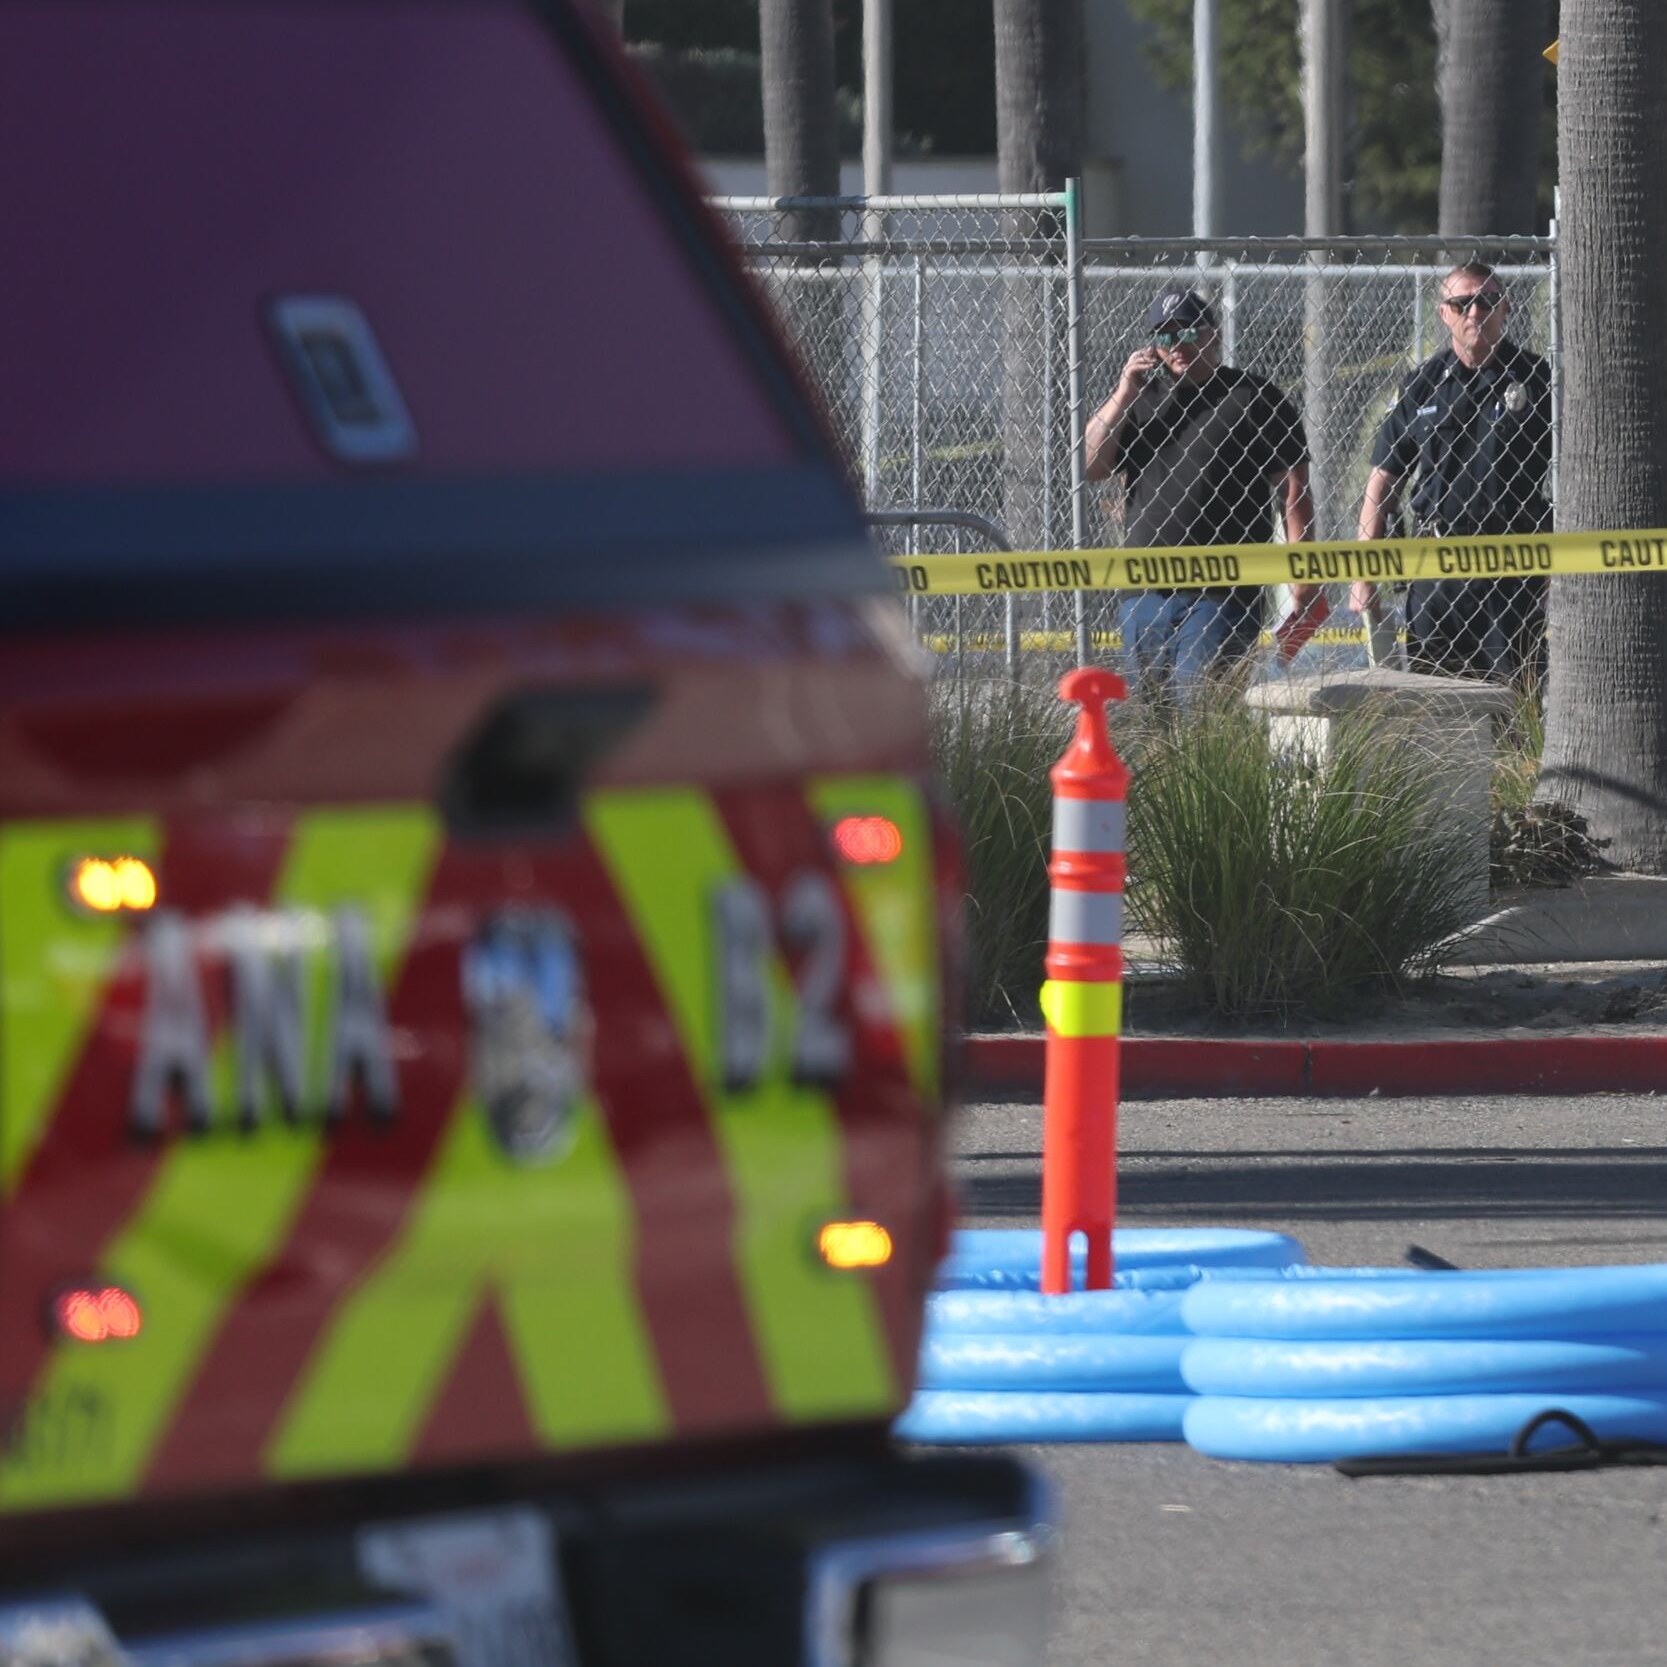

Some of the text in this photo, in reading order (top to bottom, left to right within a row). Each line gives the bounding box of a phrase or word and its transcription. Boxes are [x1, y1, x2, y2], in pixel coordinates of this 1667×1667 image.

[976, 559, 1092, 590] CAUTION
[1125, 554, 1242, 585] CUIDADO
[1288, 547, 1405, 579] CAUTION
[1436, 542, 1553, 573] CUIDADO
[130, 902, 398, 1140] ANA
